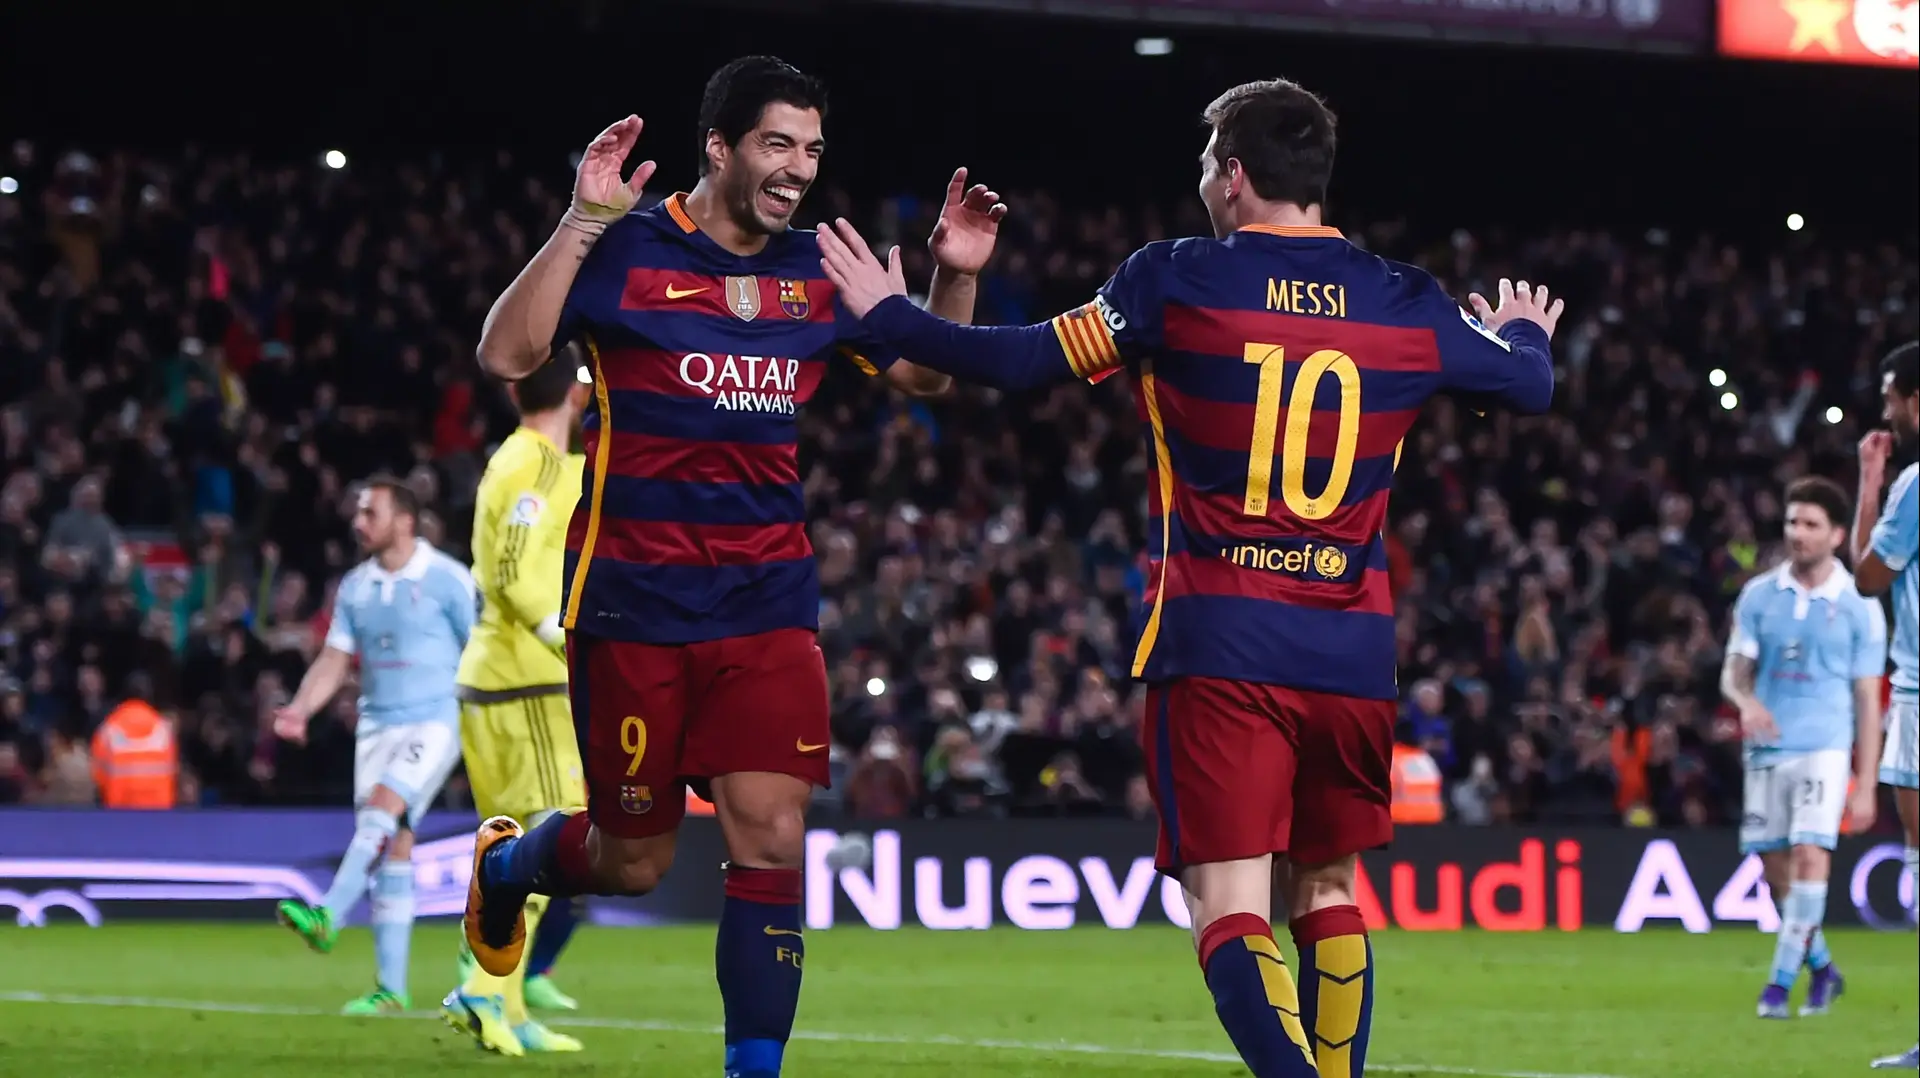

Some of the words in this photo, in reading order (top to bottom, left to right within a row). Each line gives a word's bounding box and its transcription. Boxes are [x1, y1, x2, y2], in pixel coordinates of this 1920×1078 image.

[1266, 277, 1346, 318] MESSI
[679, 352, 799, 394] QATAR
[713, 389, 795, 415] AIRWAYS
[1243, 342, 1361, 520] 10
[1221, 542, 1313, 573] unicef
[620, 716, 647, 776] 9
[1614, 838, 1782, 933] A4
